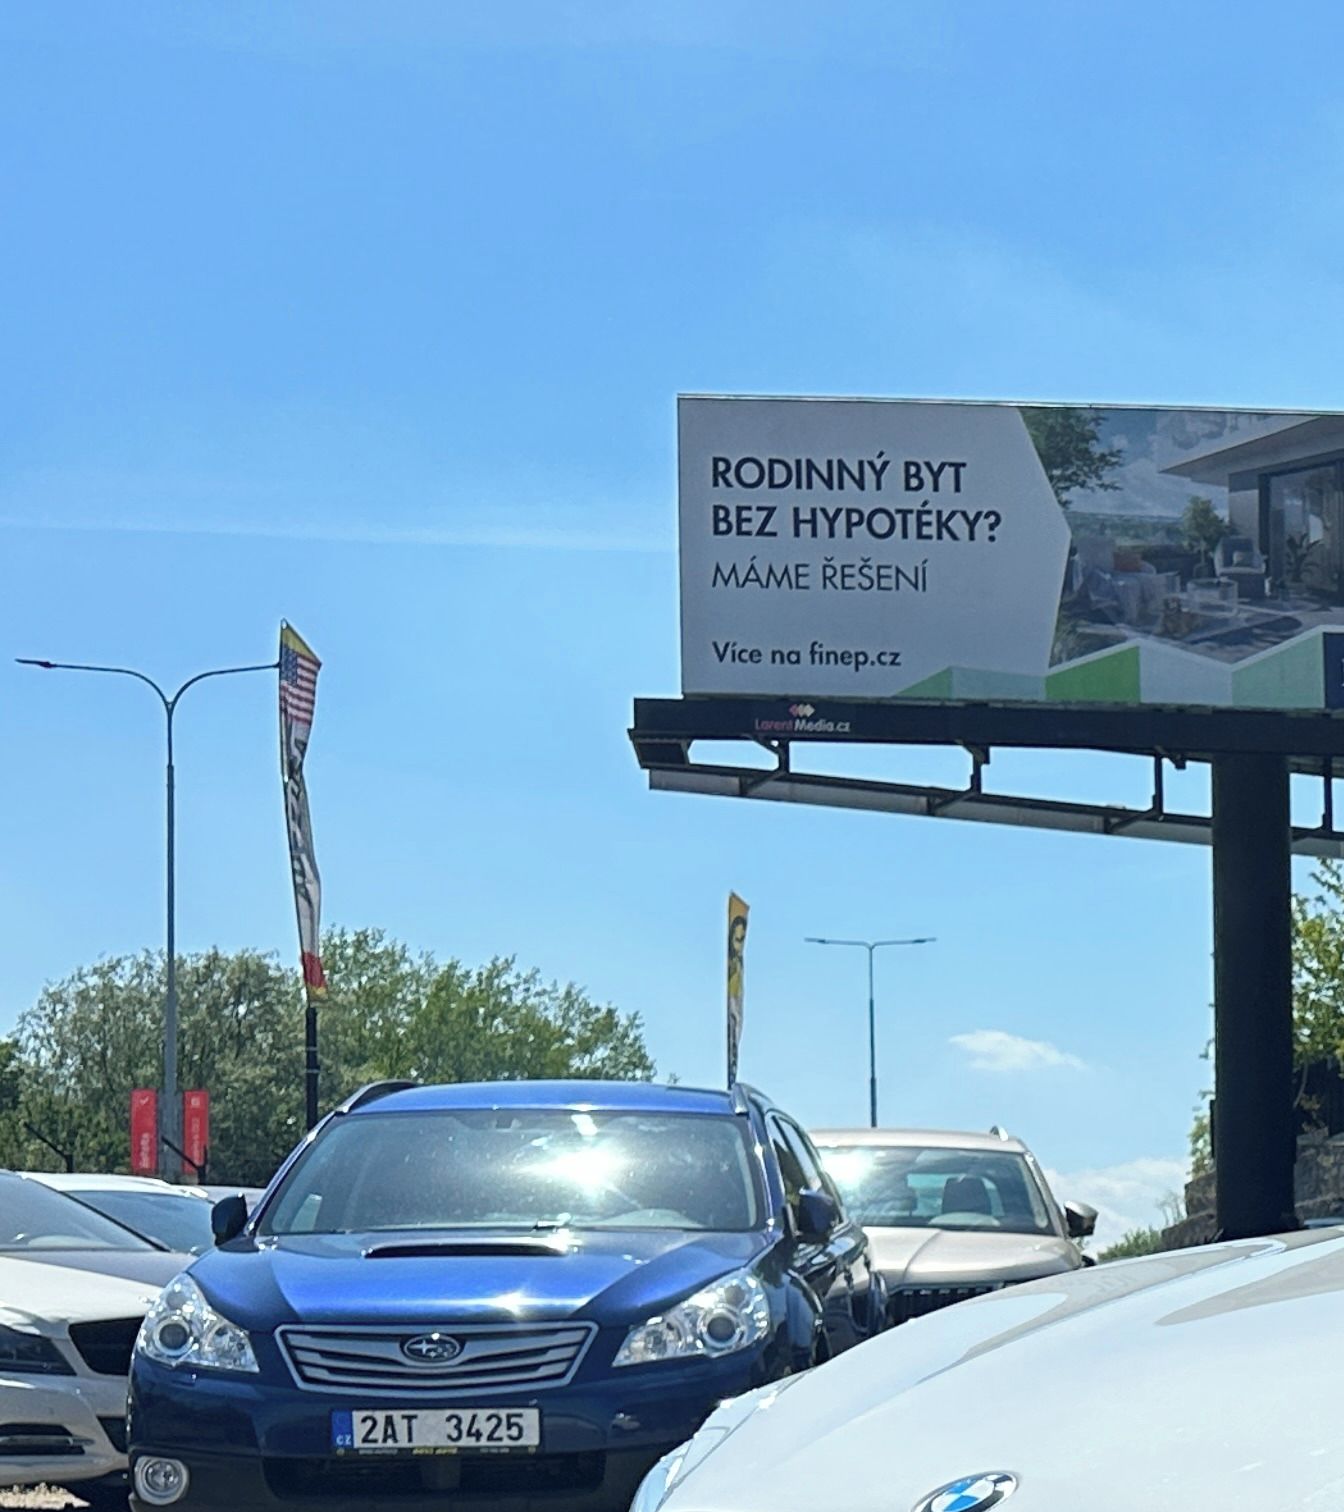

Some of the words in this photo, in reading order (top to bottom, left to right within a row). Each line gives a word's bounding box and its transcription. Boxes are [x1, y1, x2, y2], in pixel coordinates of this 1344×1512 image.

[711, 450, 890, 491] RODINNÝ
[903, 461, 967, 493] BYT
[712, 504, 778, 537] BEZ
[793, 500, 1002, 542] HYPOTÉKY?
[711, 555, 810, 591] MÁME
[822, 557, 928, 592] ŘEŠENÍ
[711, 641, 762, 664] Více
[771, 647, 801, 666] na
[809, 641, 902, 673] finep.cz
[336, 1434, 351, 1446] CZ
[360, 1414, 418, 1444] 2AT
[445, 1413, 524, 1443] 3425
